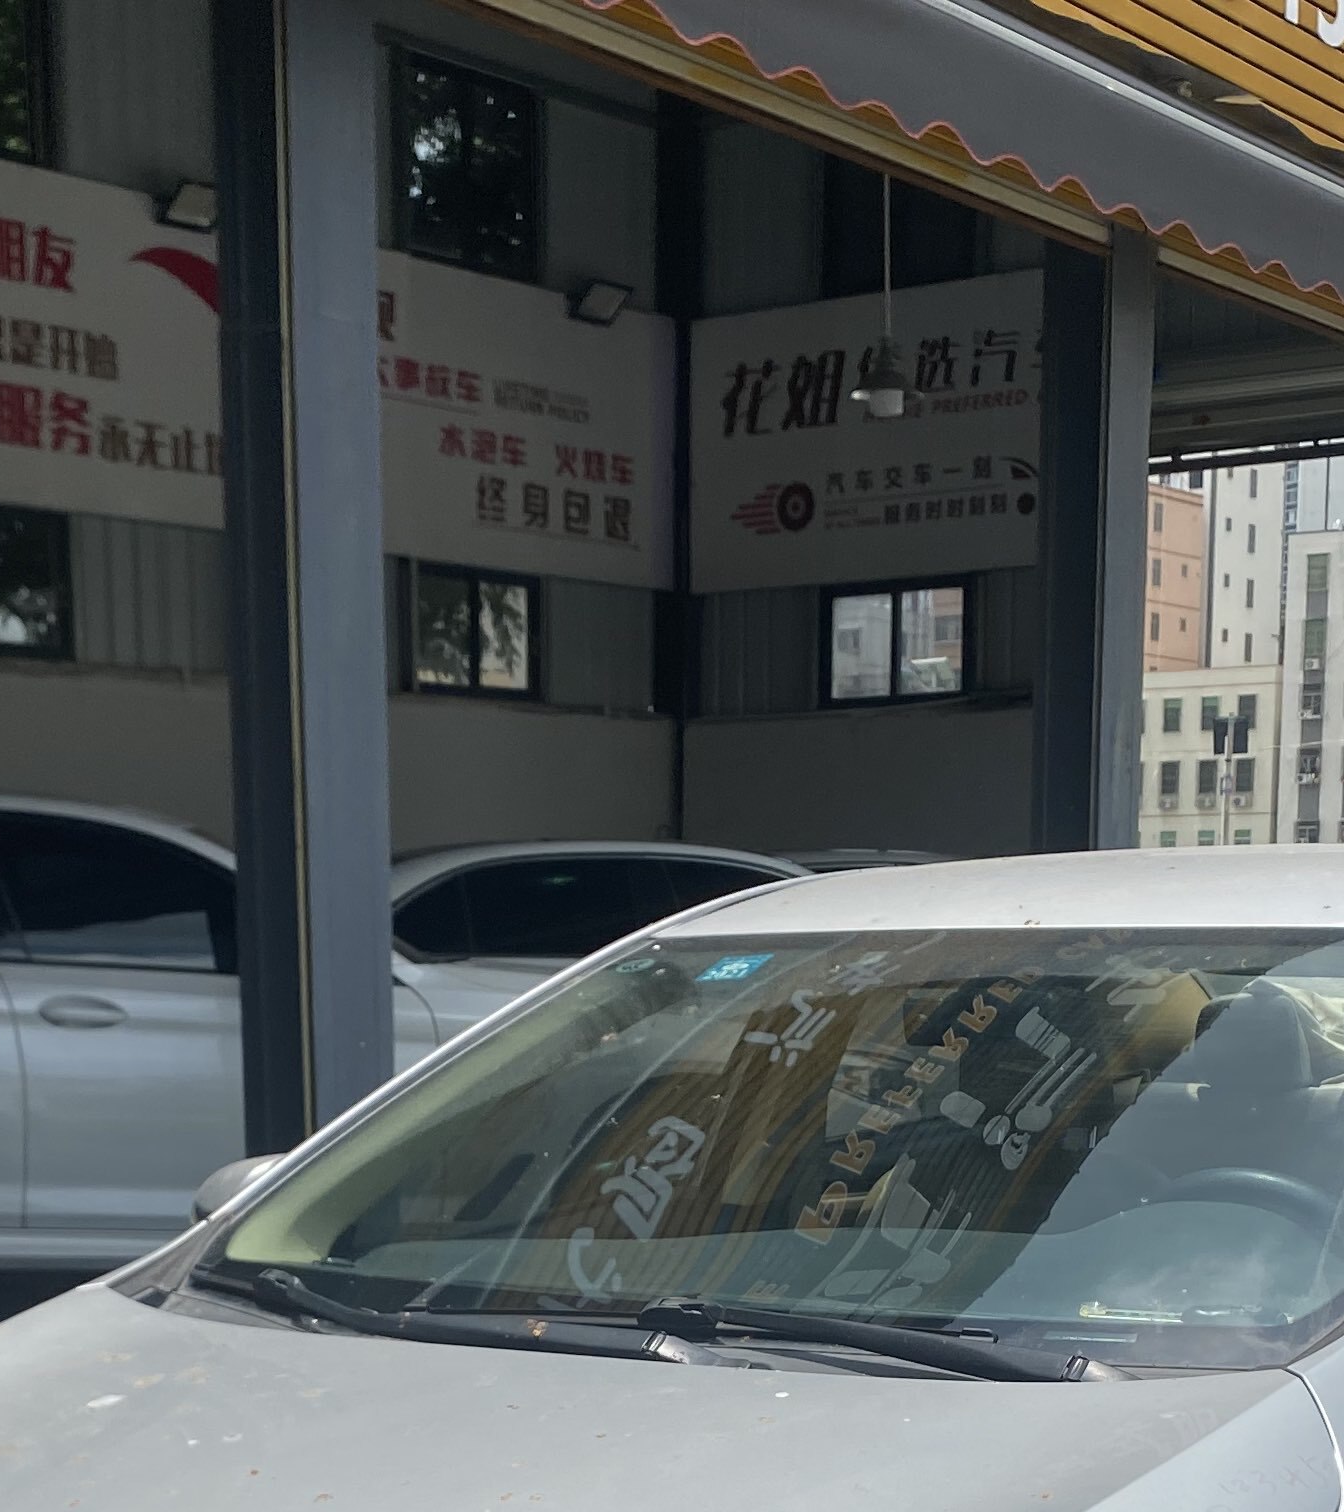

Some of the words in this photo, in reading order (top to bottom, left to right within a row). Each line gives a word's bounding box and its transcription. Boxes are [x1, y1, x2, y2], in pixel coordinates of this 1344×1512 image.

[554, 443, 636, 487] 火烧车
[477, 473, 632, 543] 终身包退
